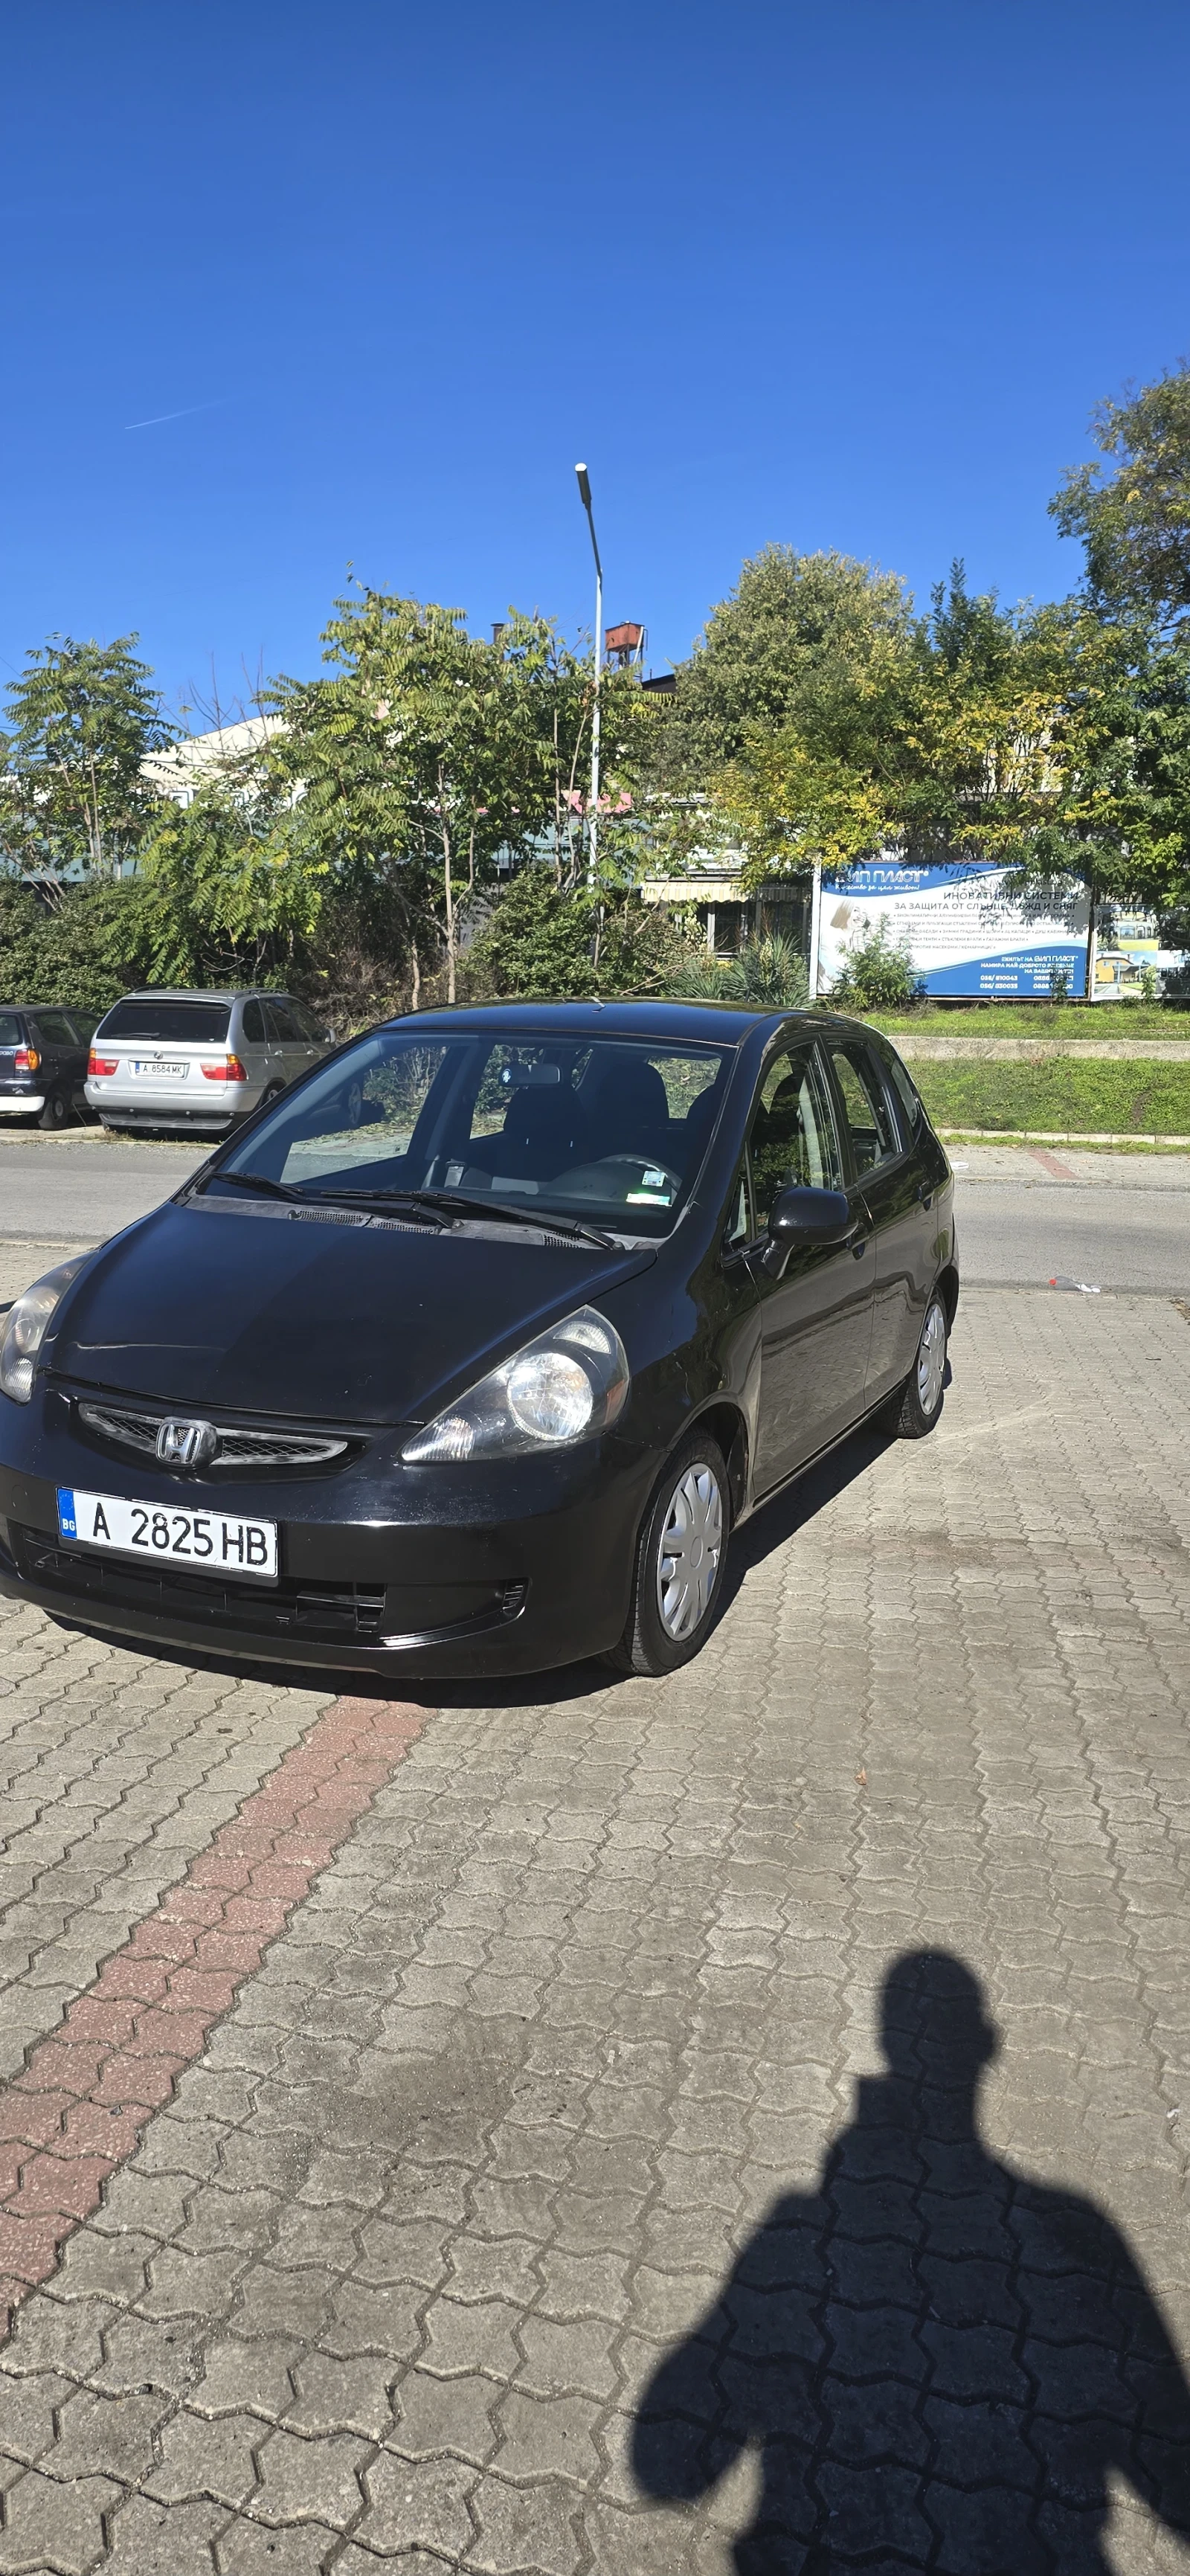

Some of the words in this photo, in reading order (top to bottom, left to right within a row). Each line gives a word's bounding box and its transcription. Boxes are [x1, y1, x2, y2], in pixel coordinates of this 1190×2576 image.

[944, 892, 1022, 900] ИНОВАТИВНИ
[1025, 892, 1078, 900] СИСТЕМИ
[909, 902, 949, 911] ЗАЩИТА
[143, 1064, 148, 1073] A
[152, 1064, 170, 1073] 8584
[172, 1065, 182, 1074] MK
[62, 1517, 76, 1532] BG
[93, 1502, 111, 1541] A
[131, 1508, 213, 1557] 2825
[222, 1522, 268, 1566] HB
